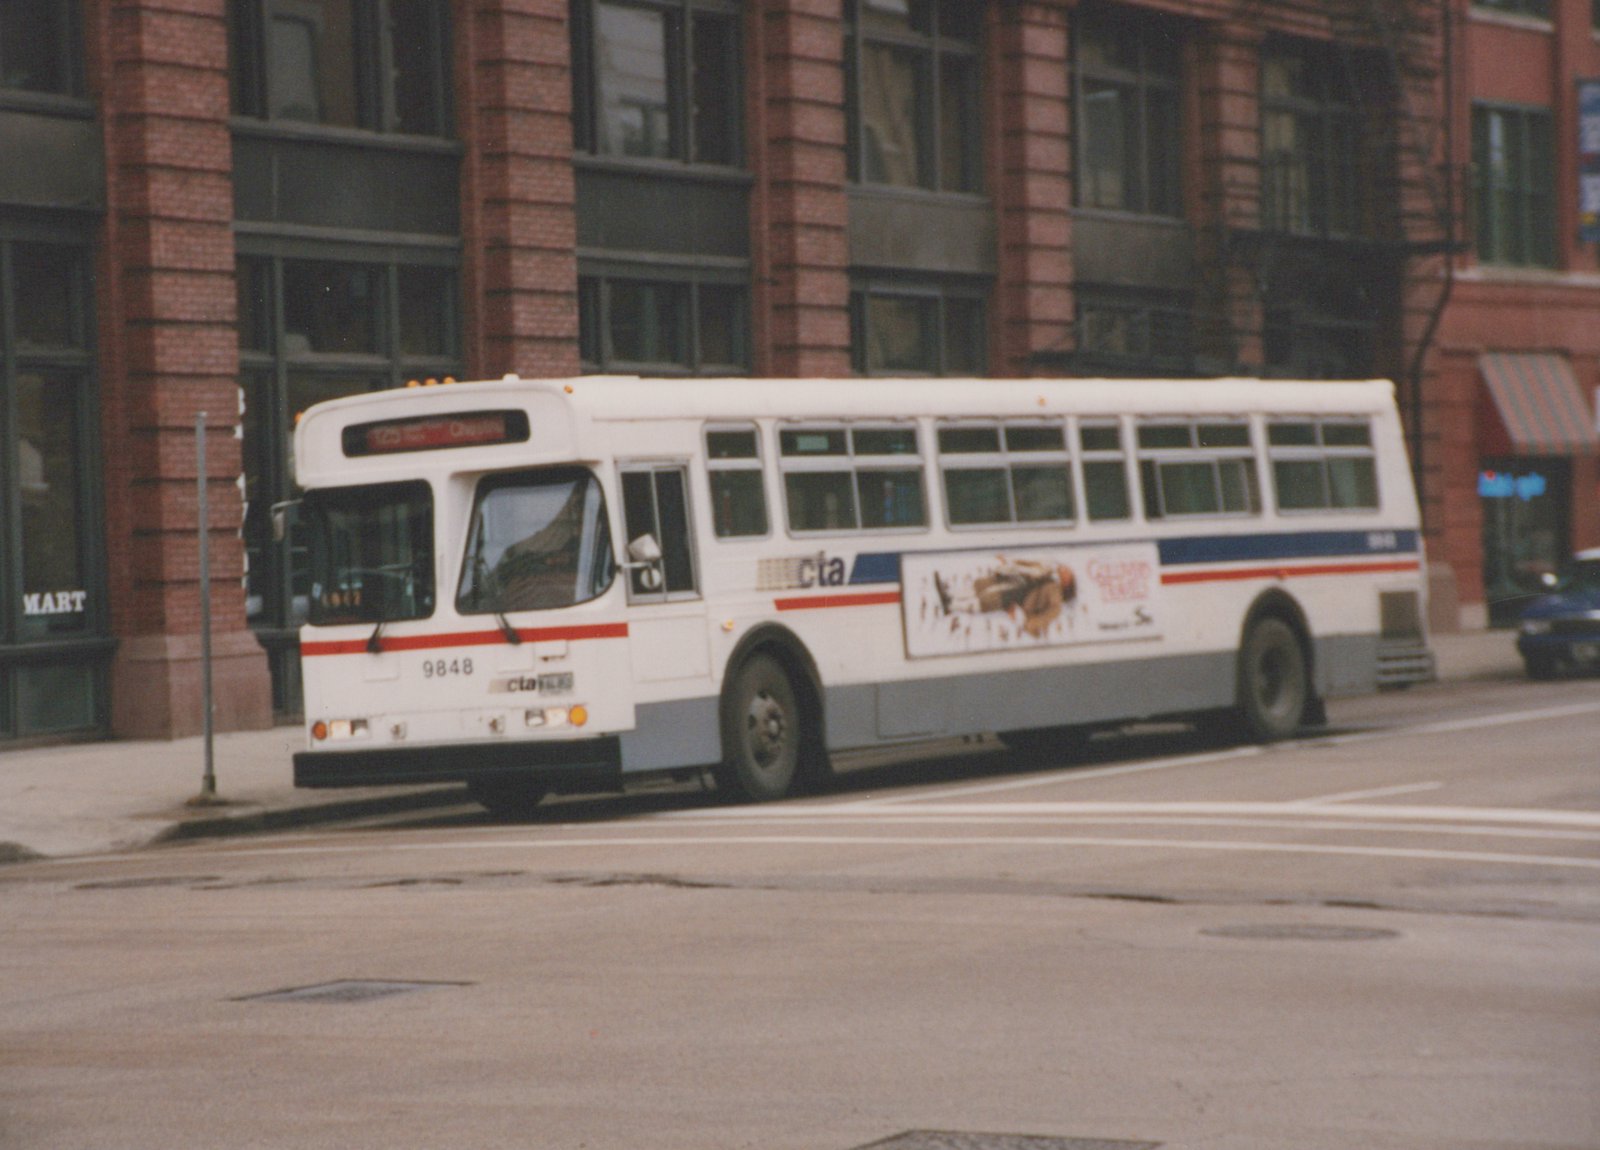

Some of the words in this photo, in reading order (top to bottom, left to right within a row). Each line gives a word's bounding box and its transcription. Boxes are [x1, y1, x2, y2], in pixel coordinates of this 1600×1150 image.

[798, 550, 845, 588] cta
[23, 591, 86, 614] MART
[423, 658, 474, 678] 9848
[507, 676, 537, 692] cta
